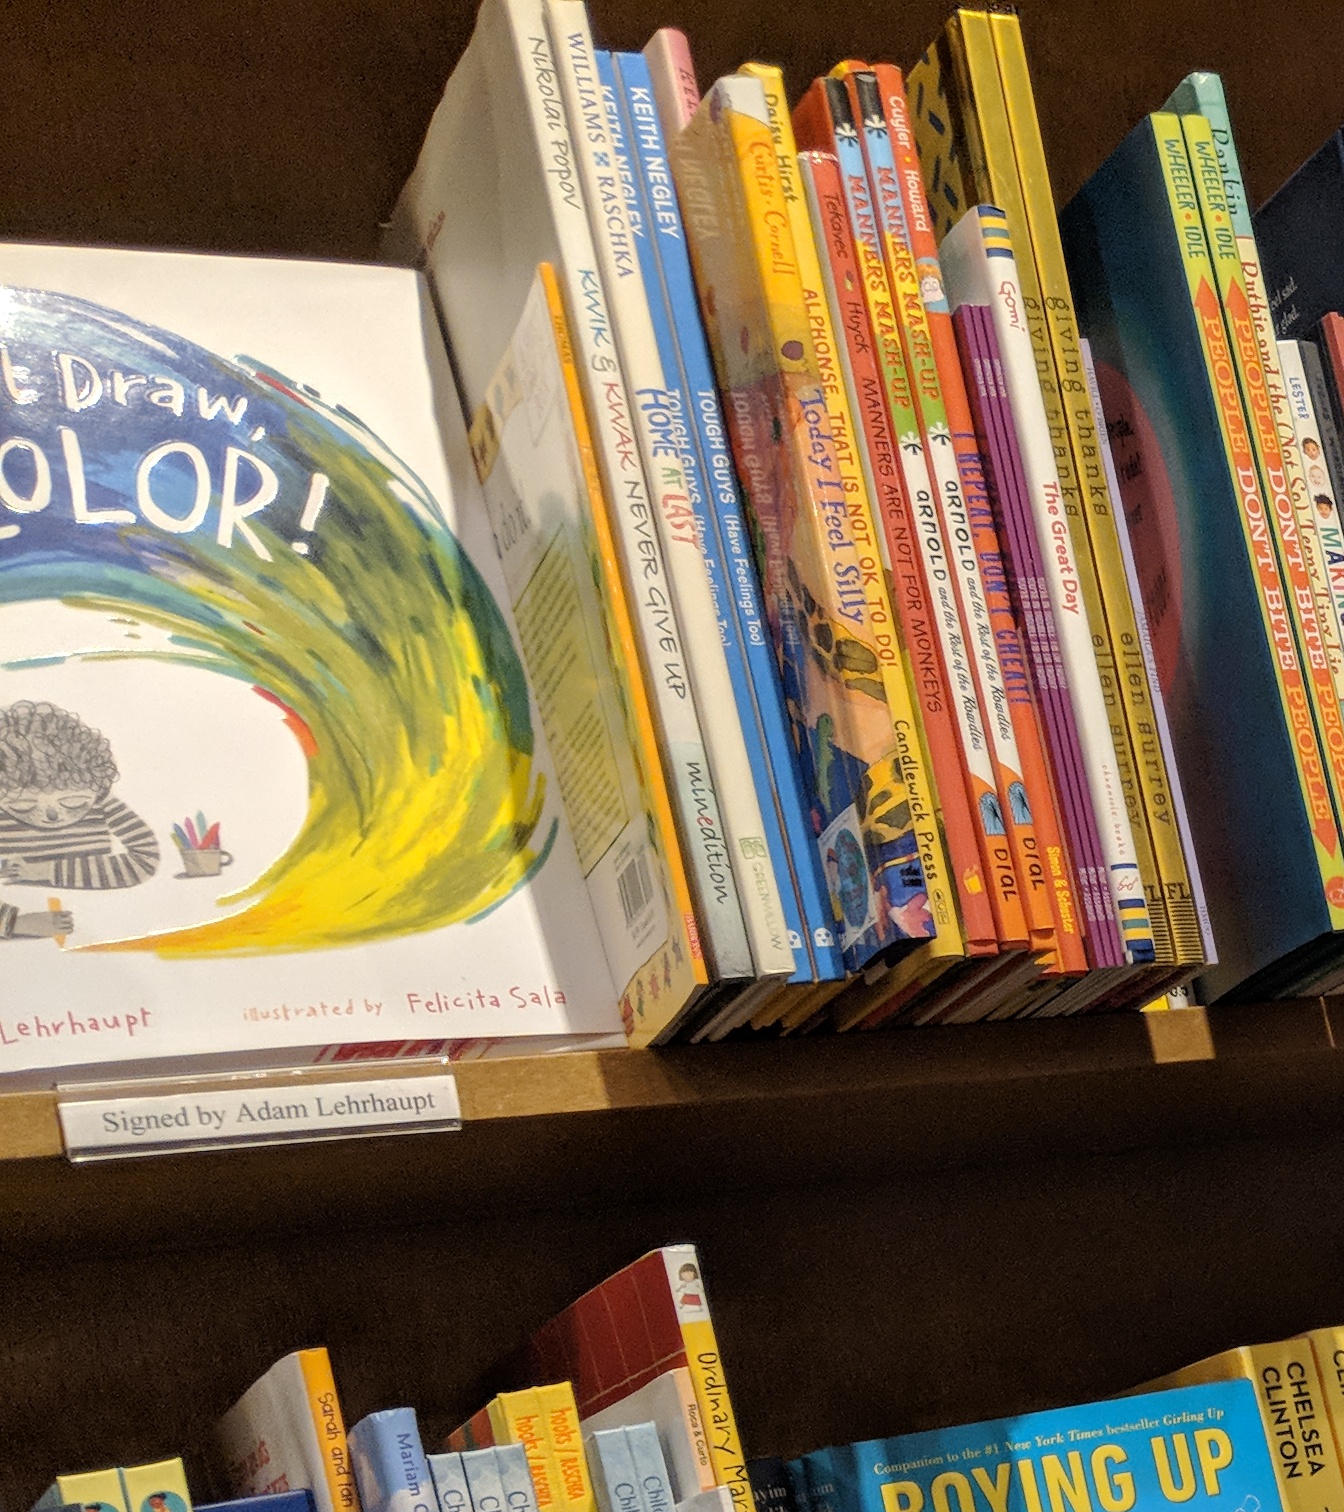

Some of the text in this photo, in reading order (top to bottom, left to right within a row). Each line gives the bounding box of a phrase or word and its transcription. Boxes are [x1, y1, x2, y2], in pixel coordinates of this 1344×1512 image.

[568, 32, 634, 278] WILLIAMS RASCHKA
[630, 86, 680, 240] KEITH NEGLEY
[904, 169, 930, 232] Howard
[1164, 139, 1205, 259] WHEELER IDLE
[1194, 141, 1236, 259] WHEELER IDLE
[998, 281, 1025, 332] Gomi
[58, 350, 265, 441] Draw,
[697, 391, 736, 504] TOUGH GUYS
[1289, 377, 1309, 419] LESTER
[0, 425, 329, 562] OLOR!
[636, 388, 699, 549] HOME LAST
[800, 388, 865, 626] Today Feel Silly
[1267, 466, 1306, 572] DON'T
[624, 480, 686, 699] NEVER GIVE UP
[829, 413, 897, 668] THAT IS NOT OK TO DO!
[862, 377, 942, 713] MANNERS ARE NOT FOR MONKEYS
[1042, 481, 1079, 615] The Great Day
[1236, 466, 1330, 820] DON'T BITE PEOPLE
[686, 761, 728, 904] minedition
[895, 720, 937, 880] Candlewick Press
[1, 1008, 152, 1045] Lehrhaupt
[243, 984, 567, 1022] illustrated Felicita Sala
[102, 1092, 437, 1133] Signed by Adam Lehrhaupt
[396, 1432, 421, 1496] Mariam
[873, 1408, 1225, 1475] Companion the York Times bestseller Girling Up
[1151, 1427, 1234, 1502] UP
[1262, 1367, 1301, 1480] CLINTON
[1286, 1361, 1326, 1476] CHELSEA
